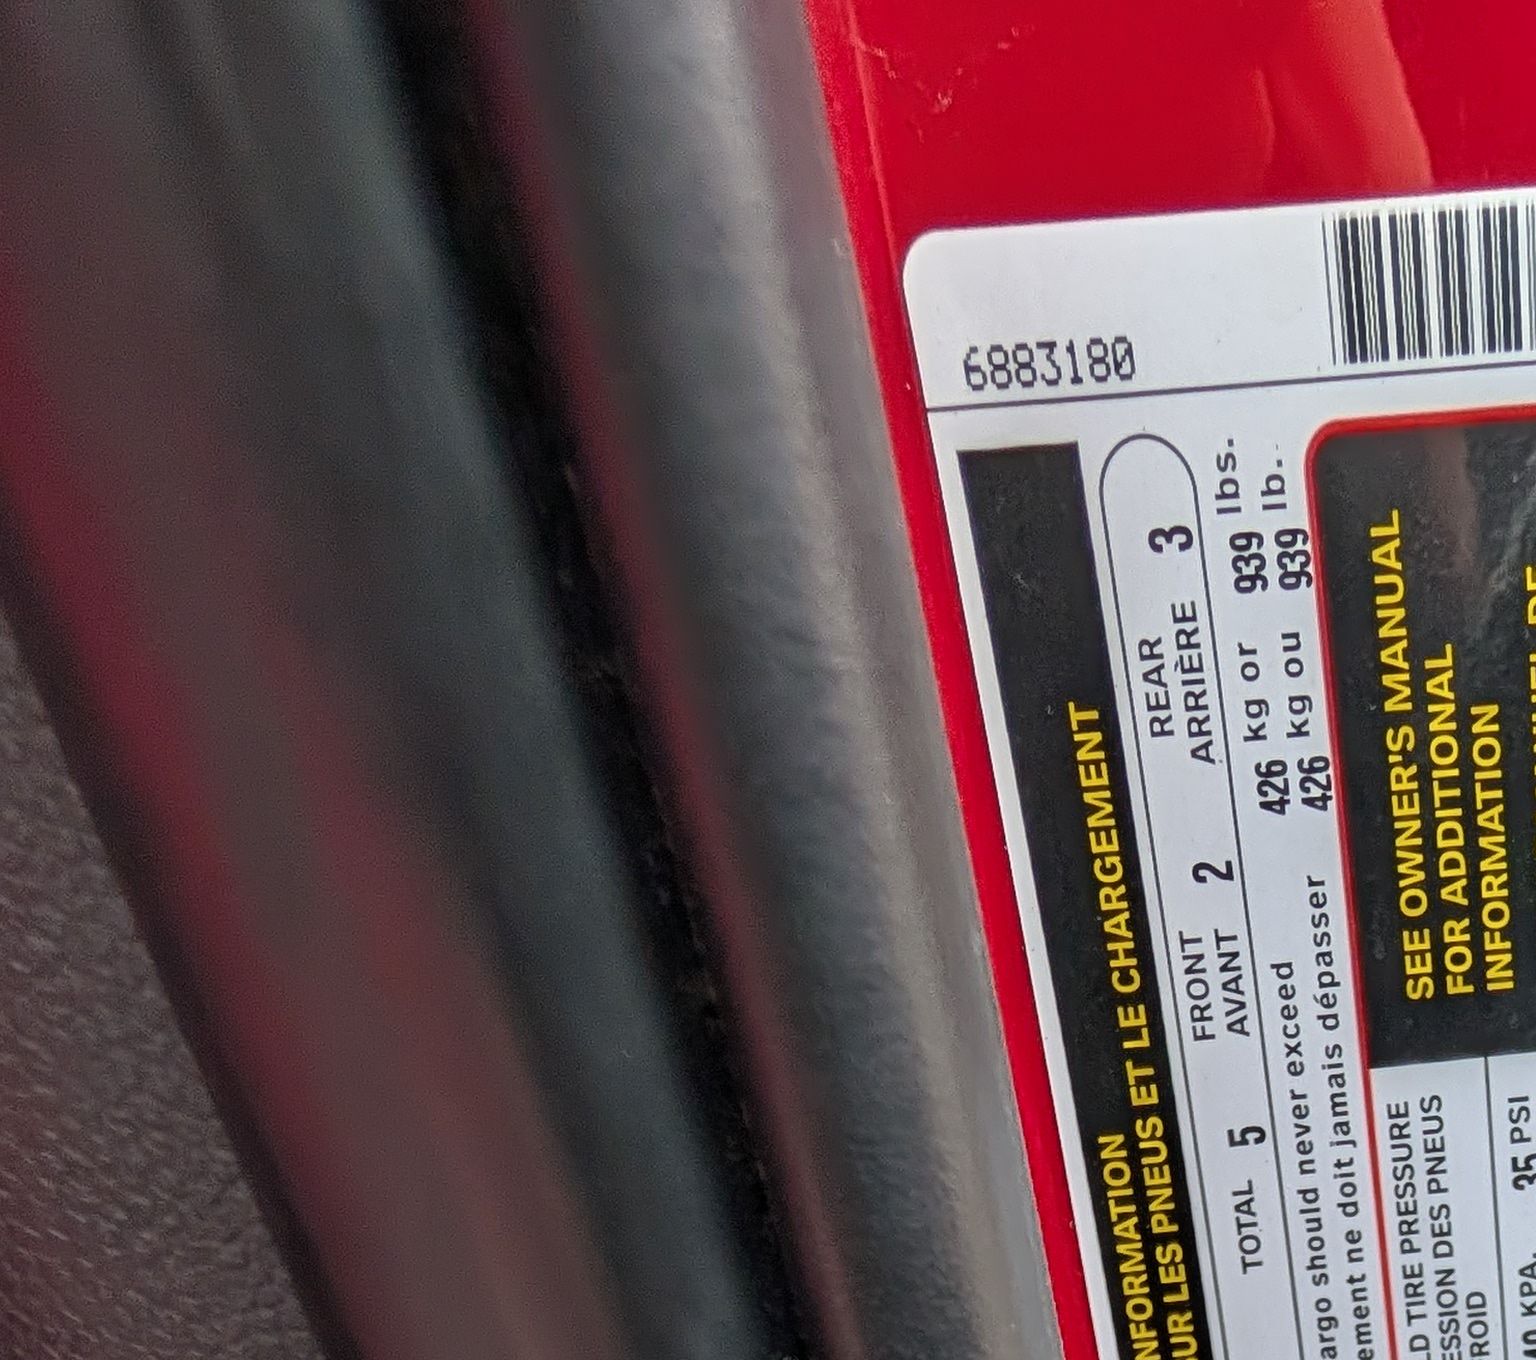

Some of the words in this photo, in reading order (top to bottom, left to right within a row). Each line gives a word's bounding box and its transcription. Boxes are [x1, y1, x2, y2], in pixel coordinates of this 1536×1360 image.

[962, 335, 1136, 392] 6883180
[1214, 438, 1242, 515] lbs.
[1147, 524, 1194, 554] 3
[1228, 531, 1269, 595] 939
[1274, 527, 1314, 591] 939
[1370, 509, 1413, 712] MANUAL
[1137, 636, 1175, 738] REAR
[1170, 600, 1216, 765] ARRIÈRE
[1237, 642, 1260, 682] or
[1281, 631, 1304, 678] ou
[1243, 698, 1270, 743] kg
[1285, 694, 1313, 739] kg
[1254, 759, 1291, 816] 426
[1296, 755, 1334, 812] 426
[1424, 643, 1469, 906] ADDITIONAL
[1067, 701, 1141, 993] CHARGEMENT
[1385, 725, 1428, 917] OWNER'S
[1470, 704, 1514, 991] INFORMATION
[1191, 860, 1235, 884] 2
[1178, 930, 1216, 1042] FRONT
[1213, 928, 1251, 1037] AVANT
[1306, 874, 1341, 1031] dépasser
[1402, 928, 1435, 1000] SEE
[1443, 917, 1475, 995] FOR
[1116, 1004, 1151, 1049] LE
[1270, 961, 1305, 1077] exceed
[1125, 1059, 1159, 1107] ET
[1321, 1043, 1357, 1148] jamais
[1226, 1125, 1267, 1148] 5
[1289, 1088, 1317, 1176] never
[1419, 1094, 1449, 1195] PNEUS
[1507, 1095, 1532, 1145] PSI
[1135, 1116, 1179, 1234] PNEUS
[1333, 1156, 1360, 1218] doit
[1386, 1101, 1422, 1255] PRESSURE
[1231, 1179, 1263, 1275] TOTAL
[1296, 1187, 1330, 1287] should
[1344, 1229, 1364, 1264] ne
[1428, 1203, 1454, 1260] DES
[1155, 1242, 1190, 1303] LES
[1401, 1262, 1427, 1328] TIRE
